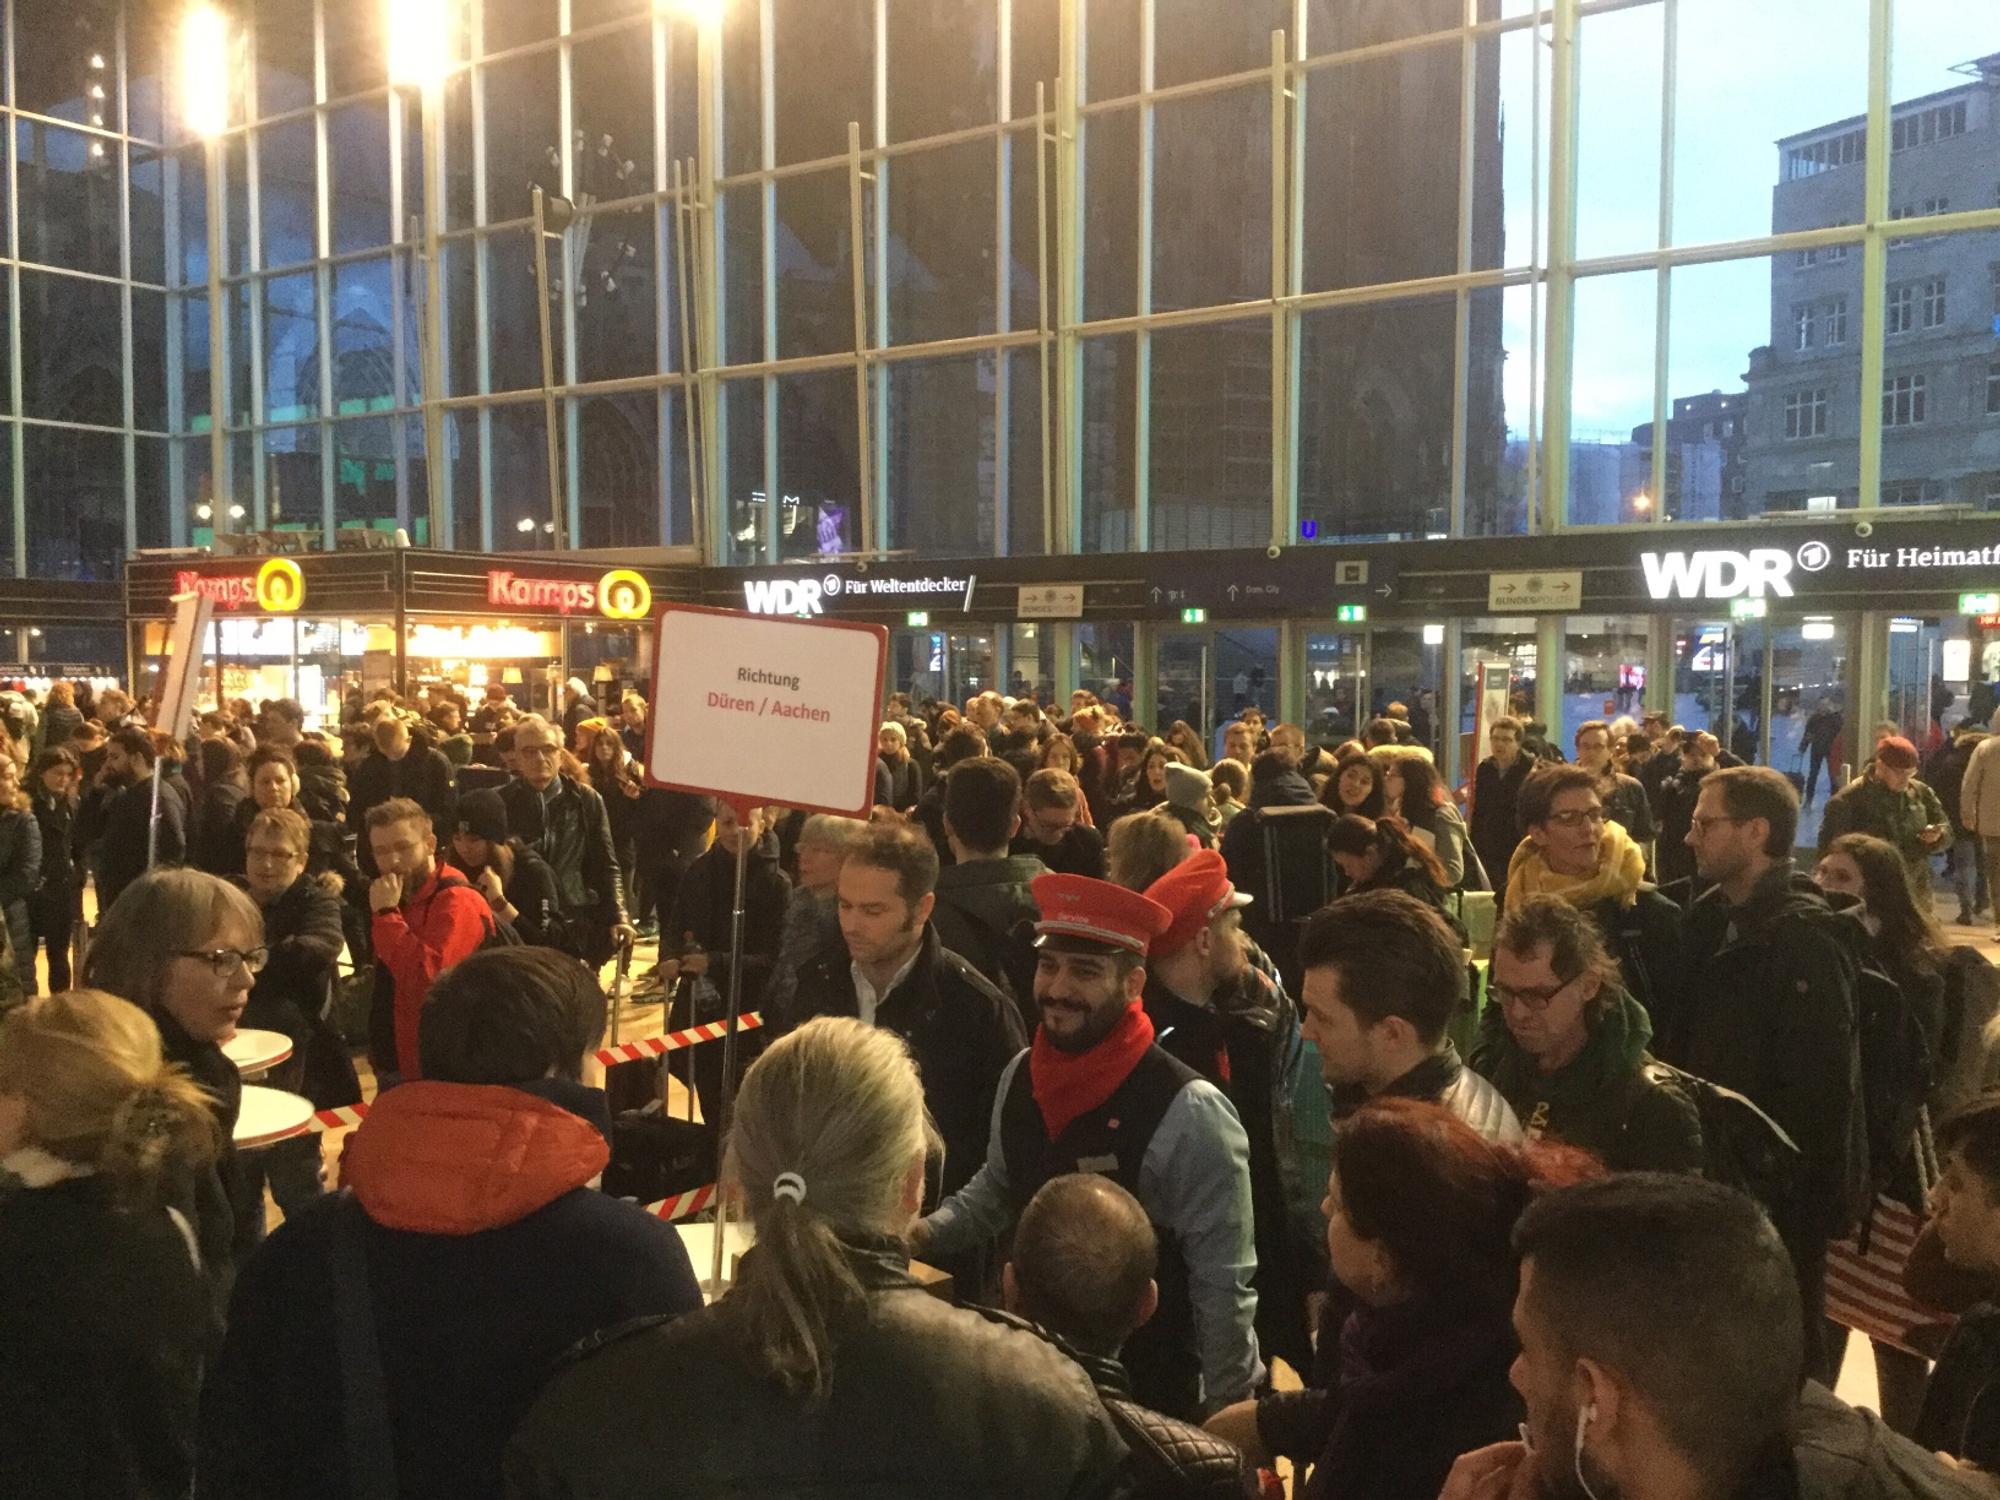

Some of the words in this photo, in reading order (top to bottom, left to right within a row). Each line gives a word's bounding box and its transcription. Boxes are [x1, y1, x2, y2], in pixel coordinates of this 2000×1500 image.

[1301, 518, 1317, 538] U
[1847, 549, 1890, 568] Für
[845, 580, 867, 594] Für
[870, 576, 966, 594] Weltentdecker
[1640, 549, 1794, 599] WDR
[488, 571, 595, 614] Kamps
[744, 579, 823, 614] WDR
[737, 667, 800, 691] Richtung
[707, 692, 755, 712] Düren
[758, 697, 768, 716] /
[771, 700, 831, 722] Aachen
